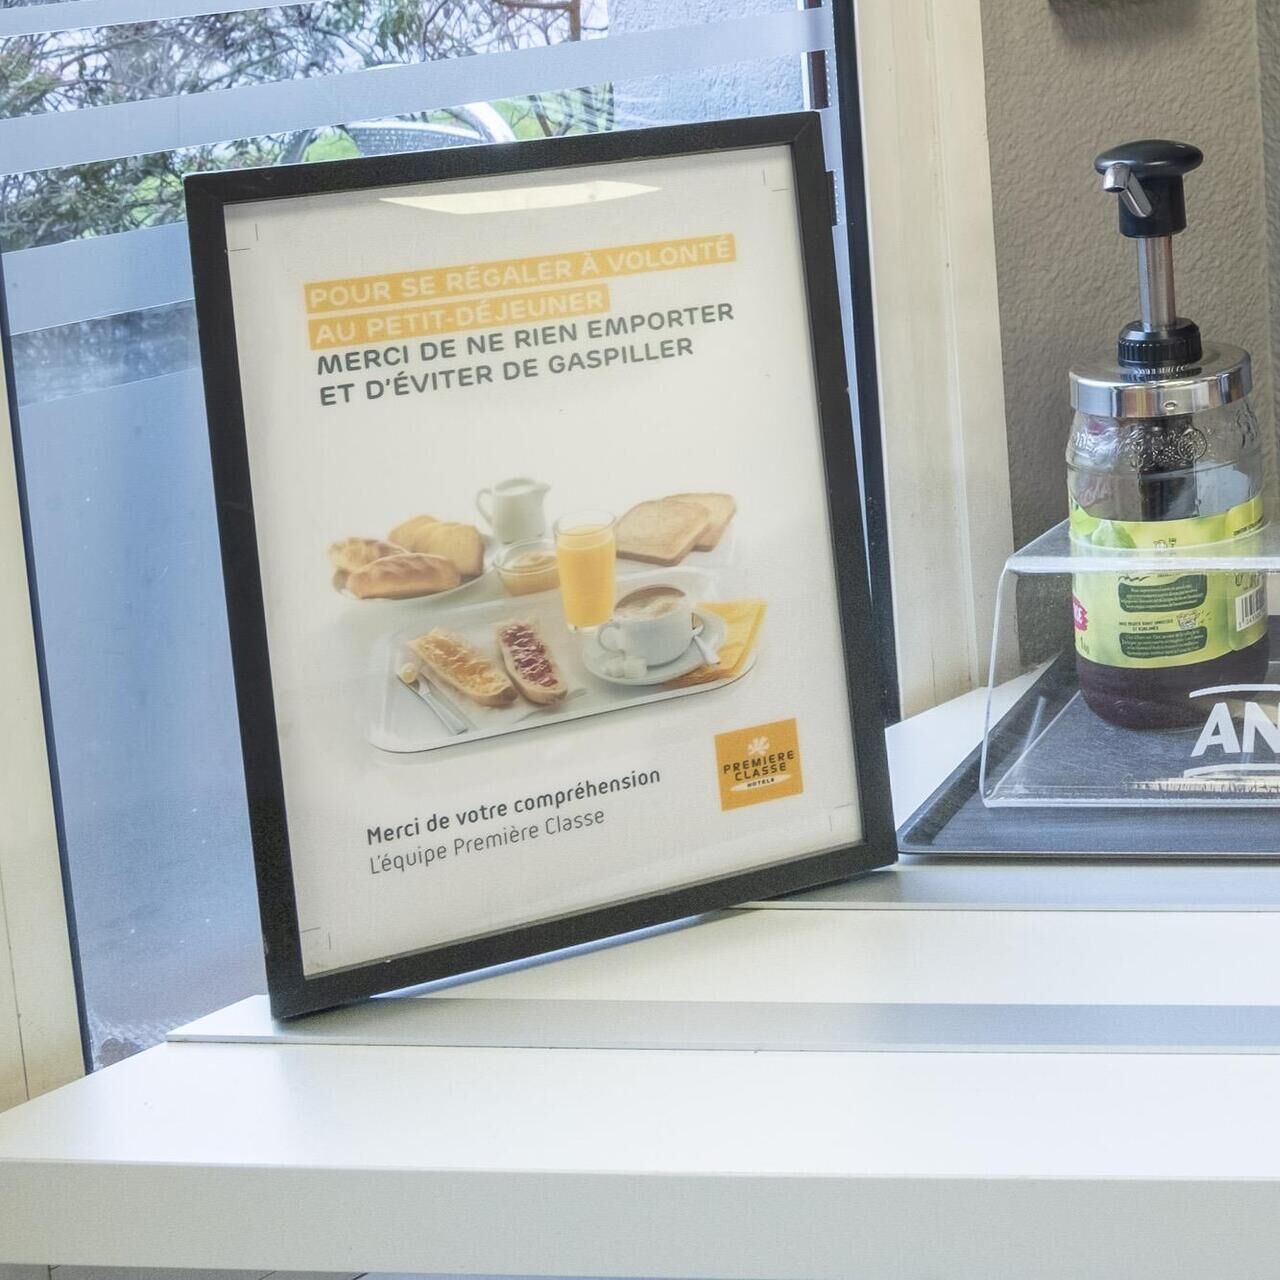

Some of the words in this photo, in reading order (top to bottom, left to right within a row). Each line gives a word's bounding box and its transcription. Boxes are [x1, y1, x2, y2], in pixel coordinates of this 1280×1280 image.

[310, 279, 391, 309] POUR
[400, 275, 436, 299] SE
[447, 258, 572, 293] RÉGALER
[581, 252, 602, 277] À
[606, 236, 731, 273] VOLONTÉ
[316, 318, 355, 345] AU
[367, 291, 604, 338] PETIT-DÉJEUNER
[317, 345, 409, 375] MERCI
[420, 338, 456, 362] DE
[467, 332, 505, 355] NE
[514, 323, 578, 349] RIEN
[588, 303, 735, 339] EMPORTER
[320, 383, 355, 406] ET
[366, 364, 493, 400] D'ÉVITER
[503, 358, 539, 381] DE
[548, 337, 694, 374] GASPILLER
[723, 750, 794, 774] PREMIERE
[735, 762, 786, 781] CLASSE
[366, 818, 420, 845] Merci
[426, 812, 450, 834] de
[456, 801, 508, 827] votre
[513, 768, 662, 815] compréhension
[369, 844, 448, 875] L'équipe
[453, 822, 539, 855] Première
[544, 808, 606, 836] Classe
